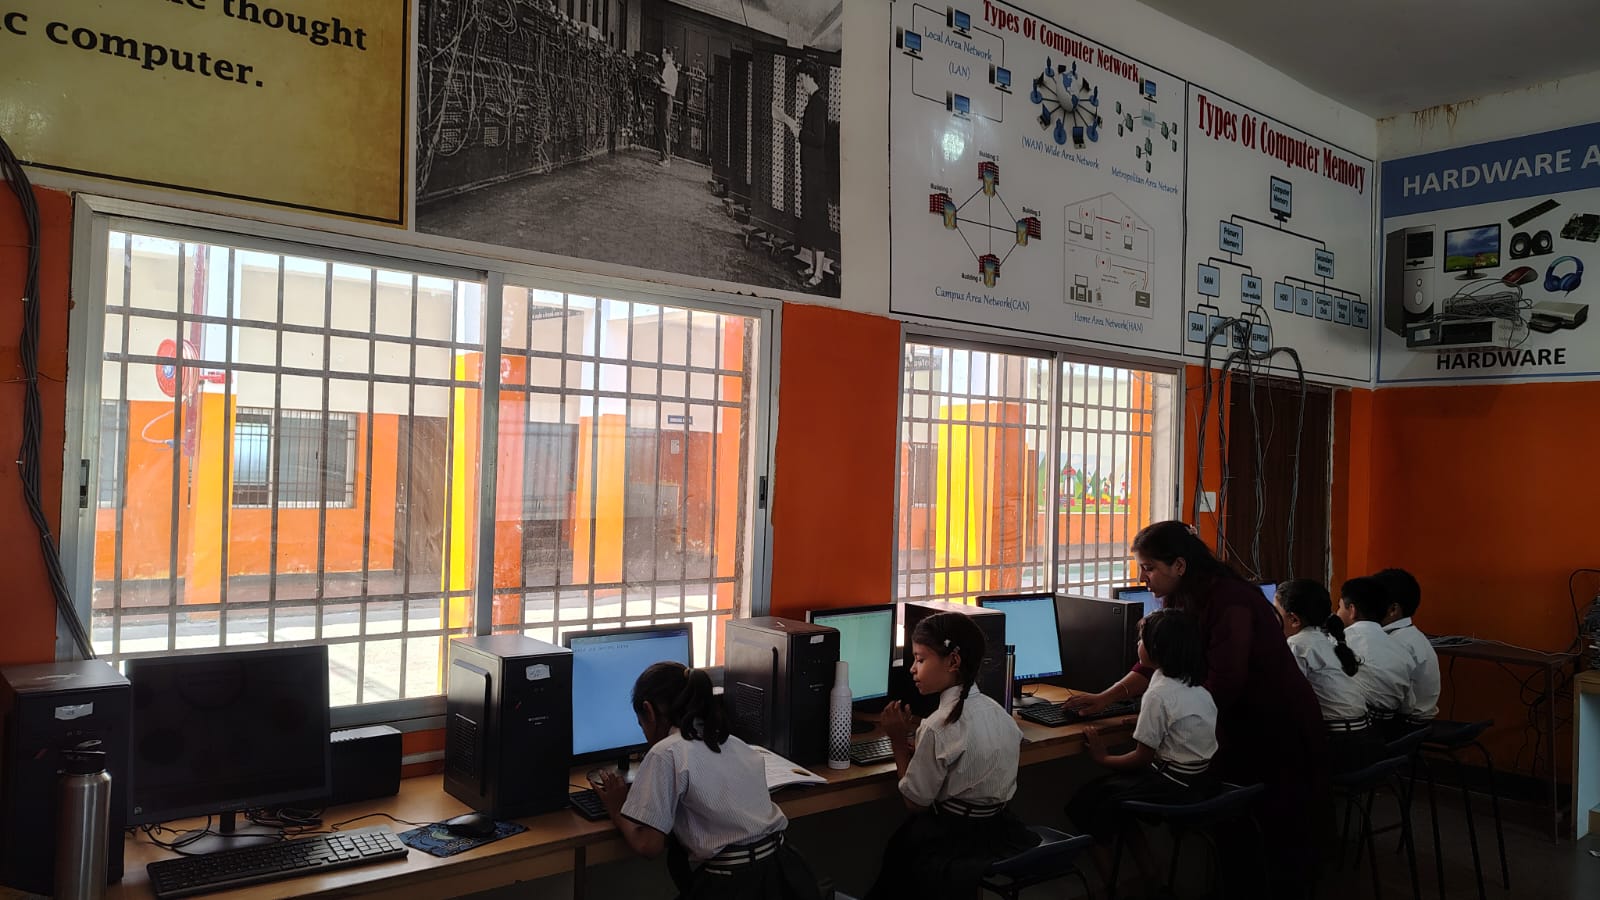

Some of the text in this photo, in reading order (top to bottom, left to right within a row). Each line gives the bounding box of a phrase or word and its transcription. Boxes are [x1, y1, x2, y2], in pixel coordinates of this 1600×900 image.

[223, 0, 367, 51] thought
[0, 12, 264, 88] c computer.
[925, 26, 993, 61] Local Area Network
[983, 0, 1139, 83] Types Of Computer Network
[949, 61, 971, 80] (LAN)
[1021, 135, 1100, 169] (WAN) Wide Area Network
[1197, 94, 1366, 195] Types Of Computer Memory
[1111, 165, 1178, 195] Metropolitan Area Network
[1403, 149, 1572, 198] HARDWARE
[1272, 183, 1290, 196] Computer
[1274, 193, 1289, 208] Memory
[1223, 226, 1240, 240] Primary
[935, 286, 964, 302] Campus
[966, 292, 982, 304] Area
[1074, 311, 1091, 324] Home
[1091, 315, 1104, 326] Area
[1436, 347, 1566, 371] HARDWARE
